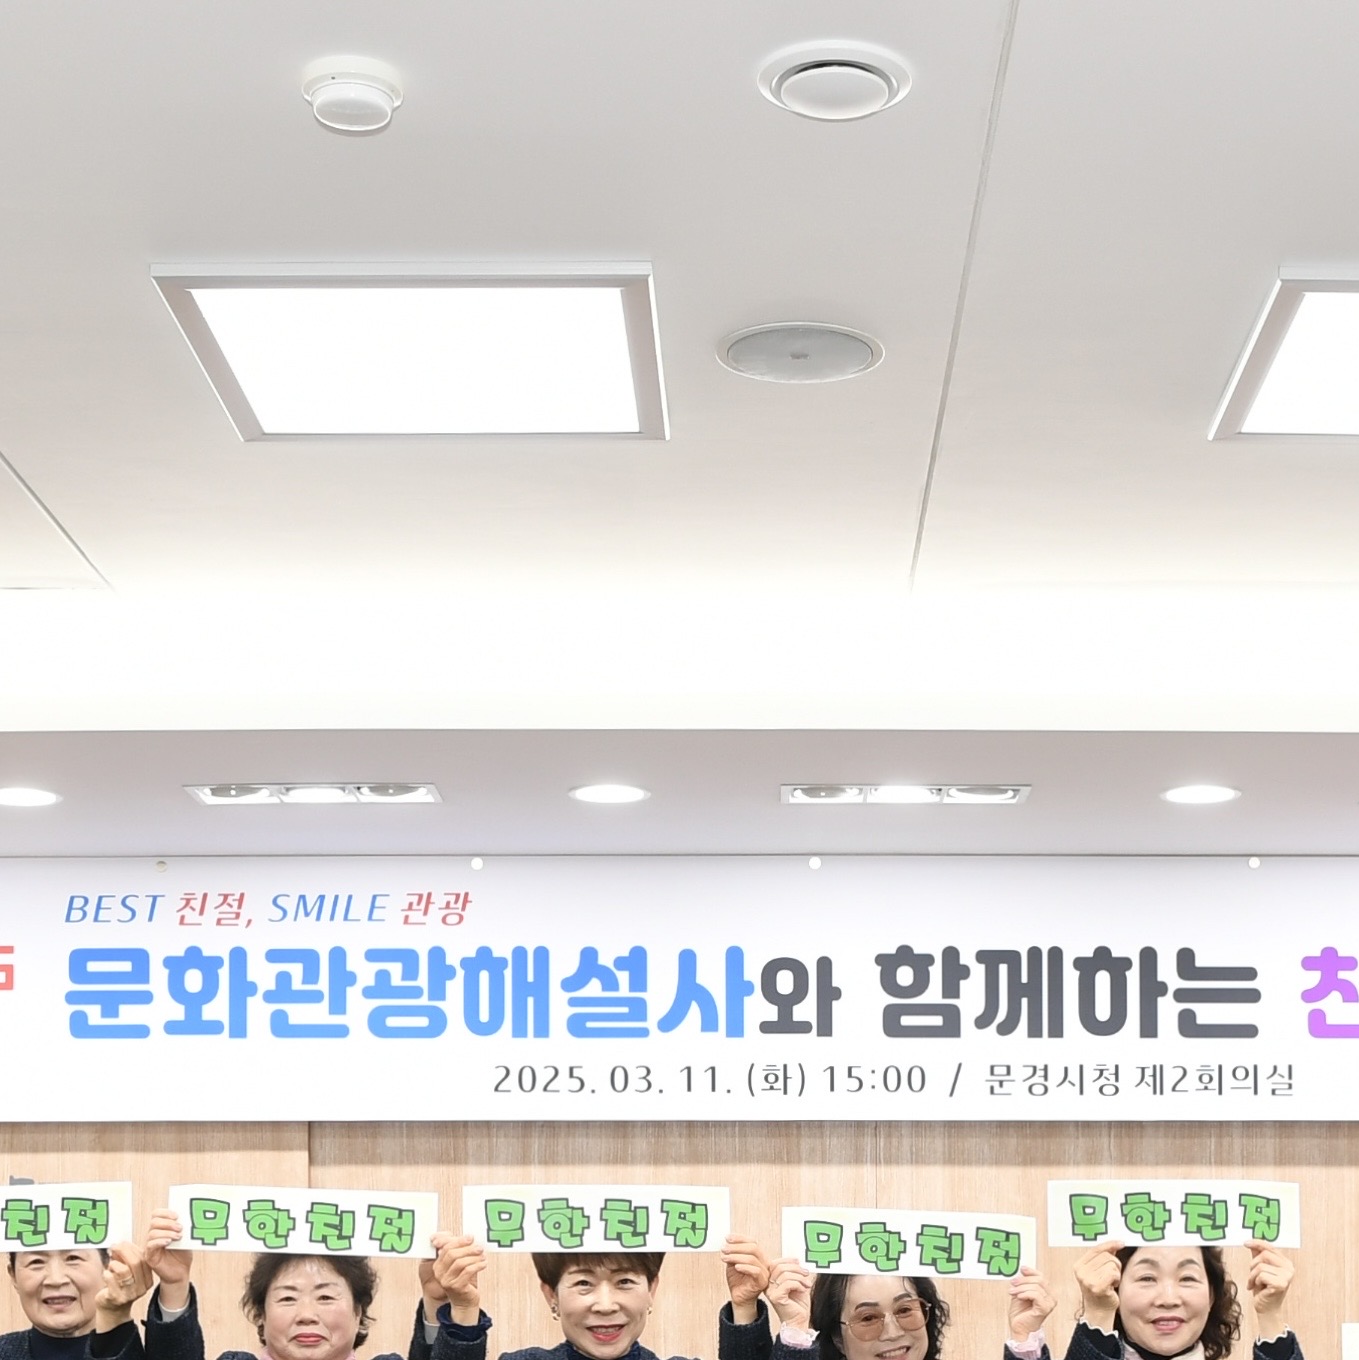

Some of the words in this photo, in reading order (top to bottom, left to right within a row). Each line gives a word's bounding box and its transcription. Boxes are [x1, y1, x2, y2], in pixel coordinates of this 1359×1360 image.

[65, 895, 165, 923] BEST
[177, 892, 252, 928] 친절,
[269, 894, 389, 922] SMILE
[401, 892, 472, 926] 관광
[64, 945, 841, 1039] 문화관광해설사와
[874, 944, 1262, 1039] 함께하는
[494, 1066, 595, 1094] 2025.
[610, 1065, 663, 1094] 03.
[680, 1066, 731, 1093] 11.
[748, 1063, 805, 1097] (화)
[824, 1065, 925, 1093] 15:00
[986, 1064, 1119, 1096] 문경시청
[1135, 1064, 1292, 1096] 제2회의실
